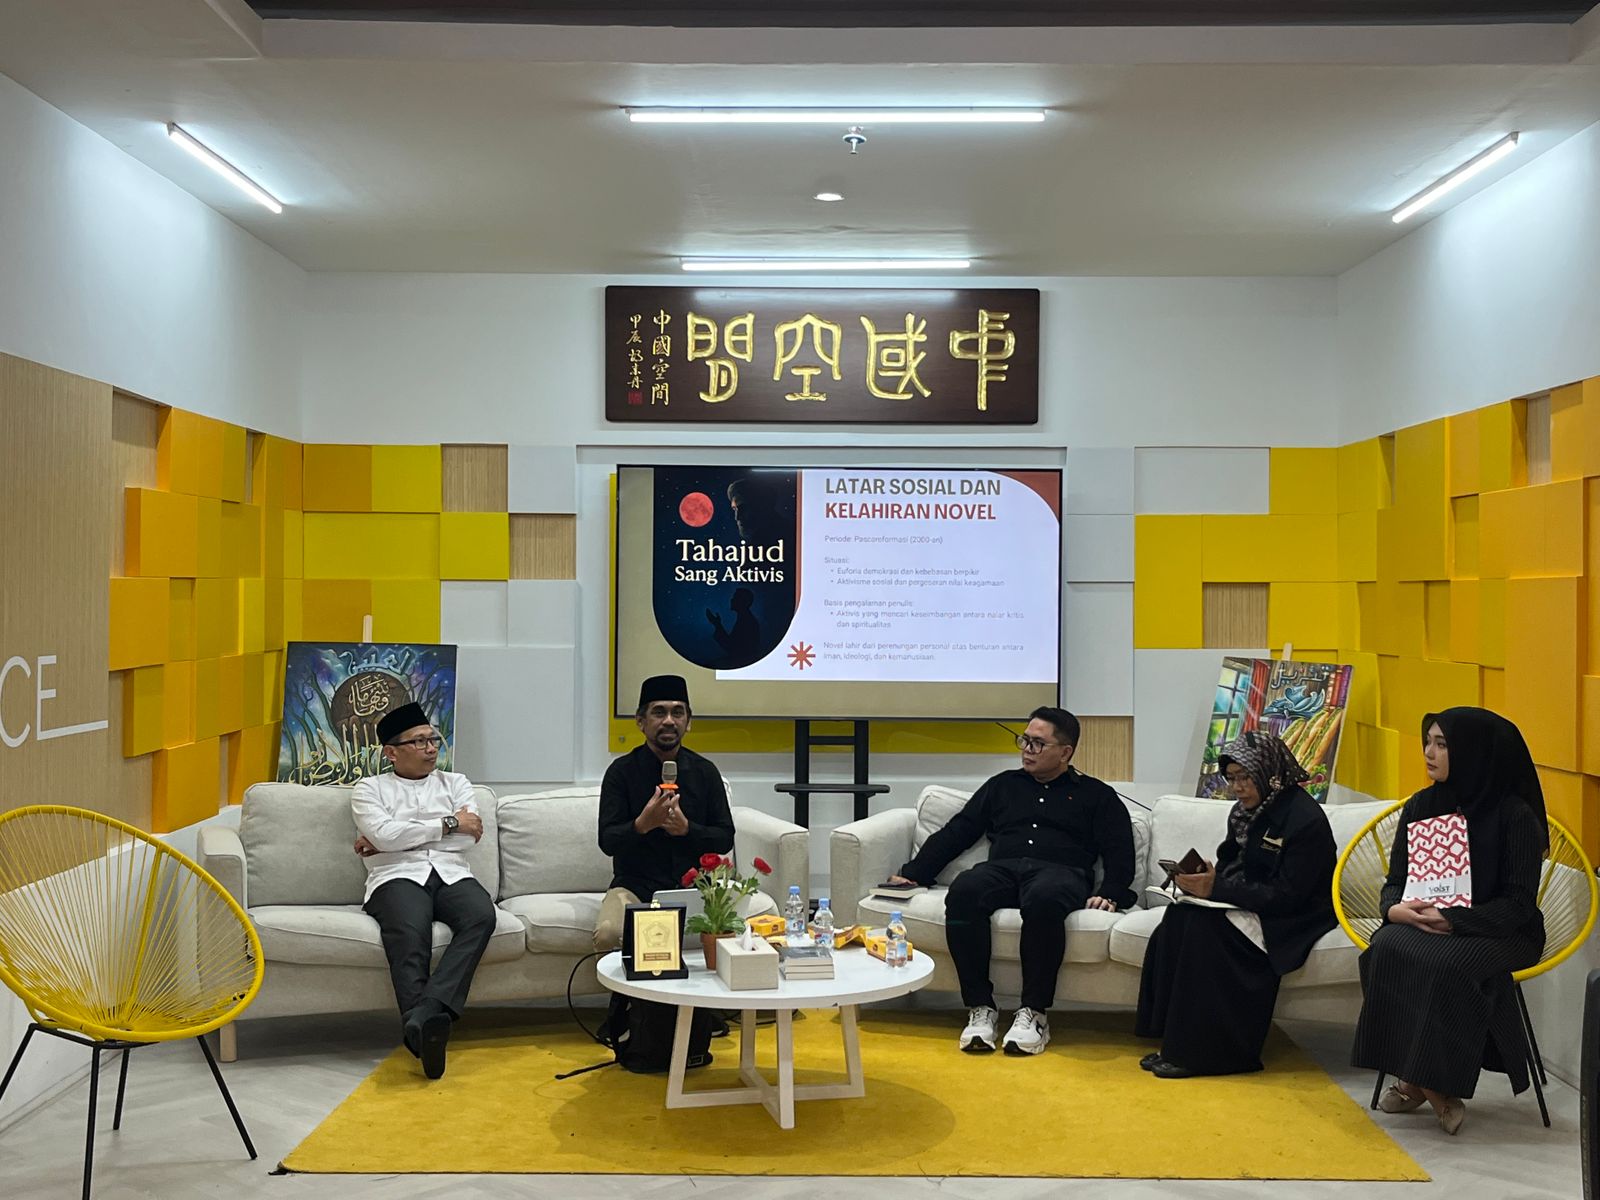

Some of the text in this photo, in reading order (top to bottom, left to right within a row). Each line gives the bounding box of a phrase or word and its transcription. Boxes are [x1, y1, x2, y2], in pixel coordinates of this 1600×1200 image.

[651, 309, 672, 406] 中國空間
[825, 478, 1001, 496] LATAR SOSIAL DAN
[825, 502, 996, 520] KELAHIRAN NOVEL
[675, 538, 785, 566] Tahajud
[674, 566, 784, 586] Sang Aktivis
[953, 568, 980, 577] berpikir
[872, 578, 893, 586] sosial
[908, 580, 947, 588] pergeseran
[964, 579, 1005, 588] keagamaan
[824, 599, 843, 607] Basis
[844, 600, 886, 608] pengalaman
[862, 611, 879, 619] yang
[910, 611, 961, 620] keseimbangan
[851, 621, 892, 629] spiritualitas
[877, 643, 919, 651] perenungan
[920, 643, 950, 651] personal
